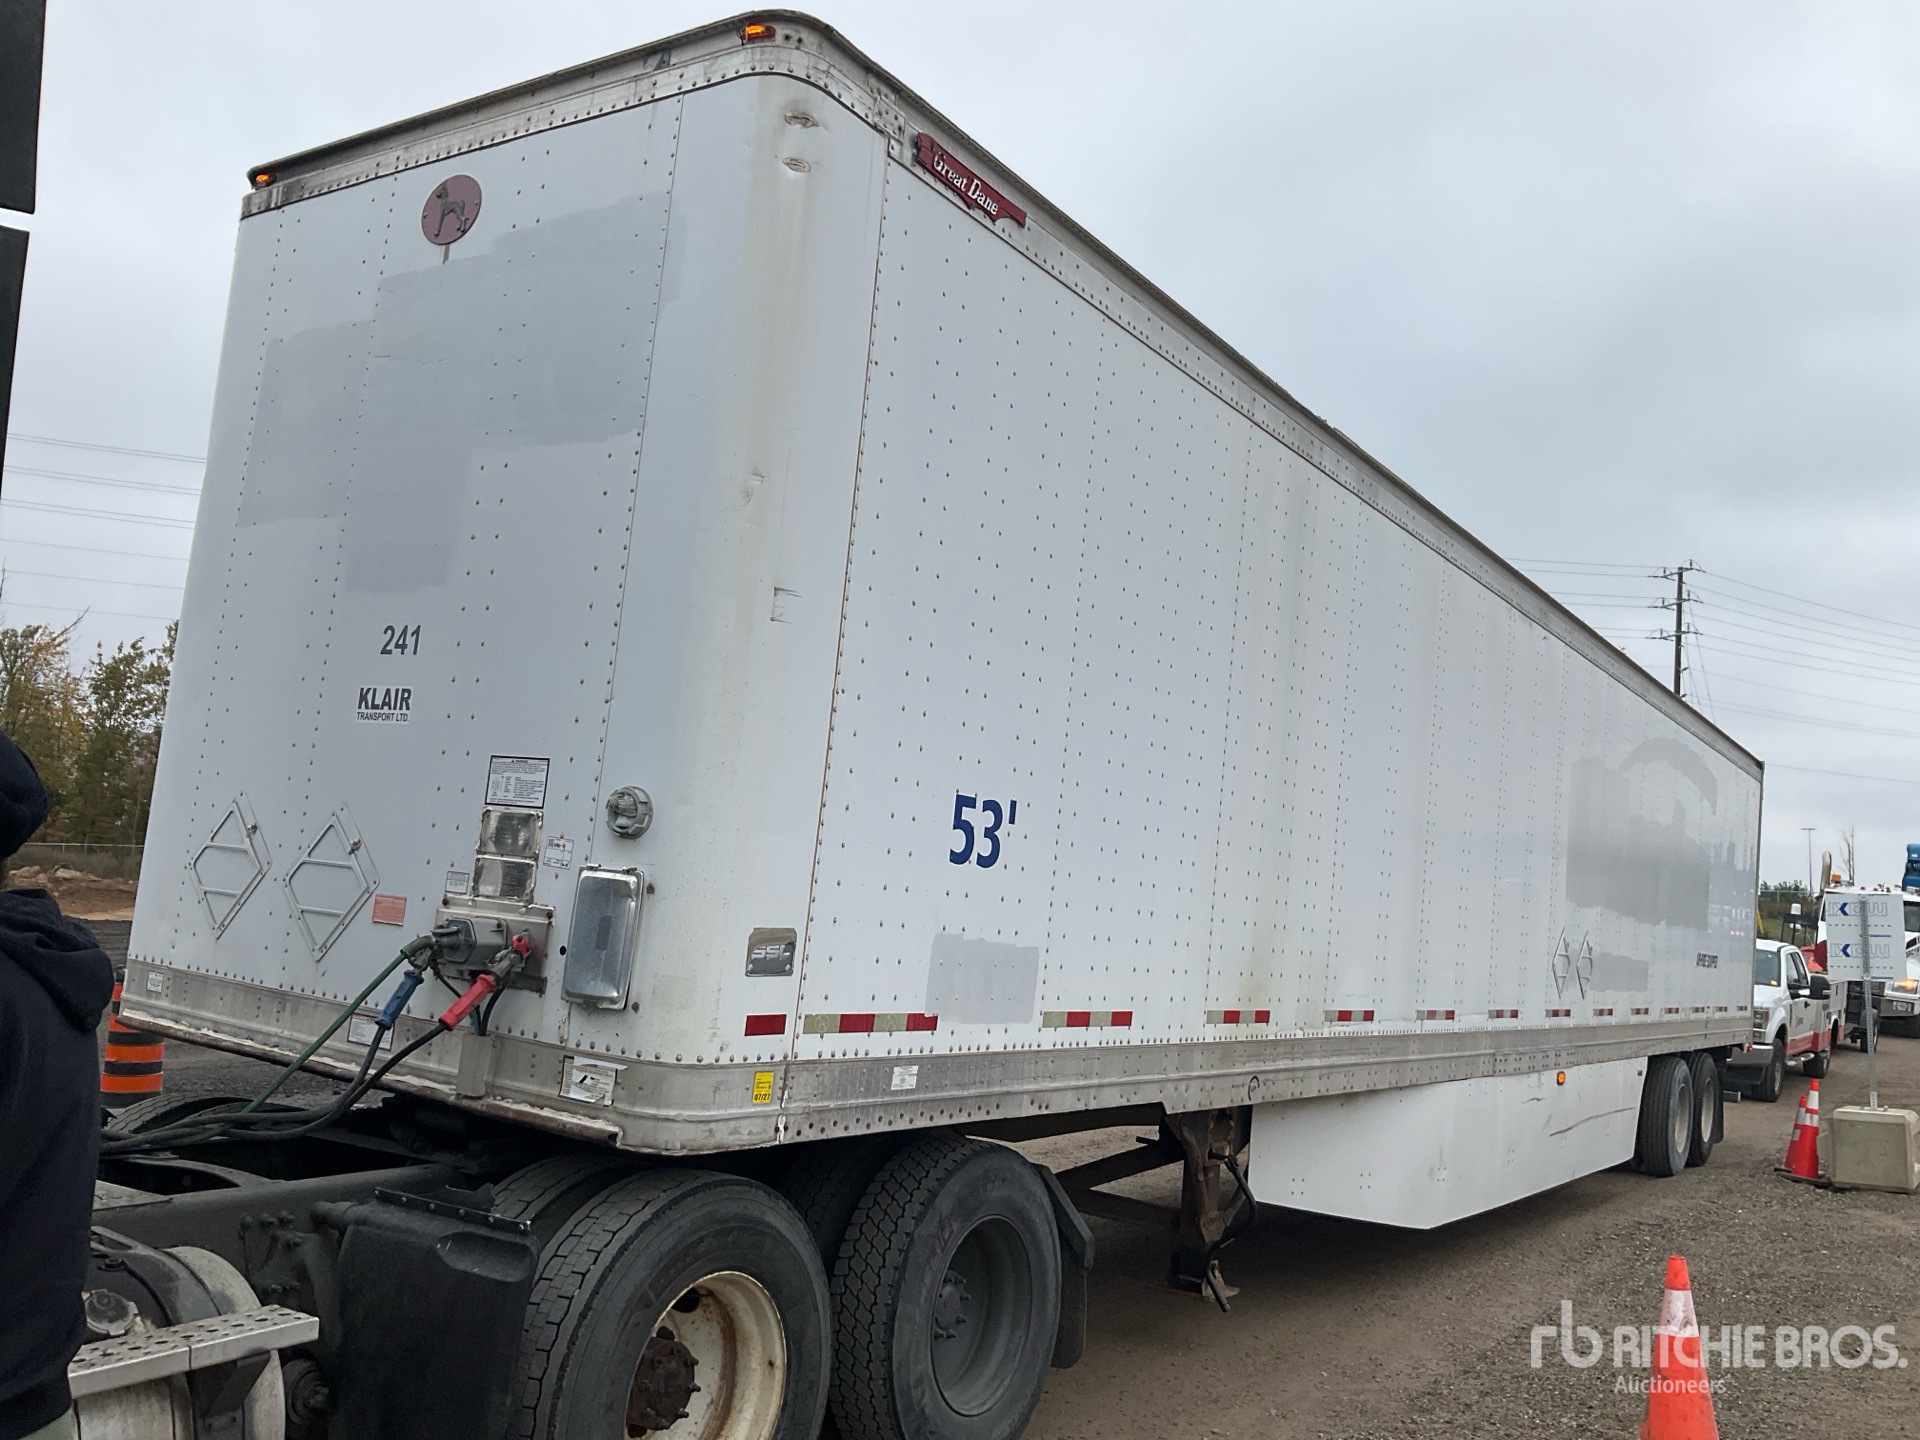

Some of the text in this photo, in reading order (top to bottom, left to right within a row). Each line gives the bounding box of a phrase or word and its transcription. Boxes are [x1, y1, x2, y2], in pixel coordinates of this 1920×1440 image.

[933, 151, 999, 215] Great Dane
[380, 624, 421, 656] 241
[357, 687, 412, 711] KLAIR
[356, 711, 410, 722] TRANSPORT LTD.
[949, 793, 1017, 869] 53'
[754, 1092, 771, 1101] 07/27
